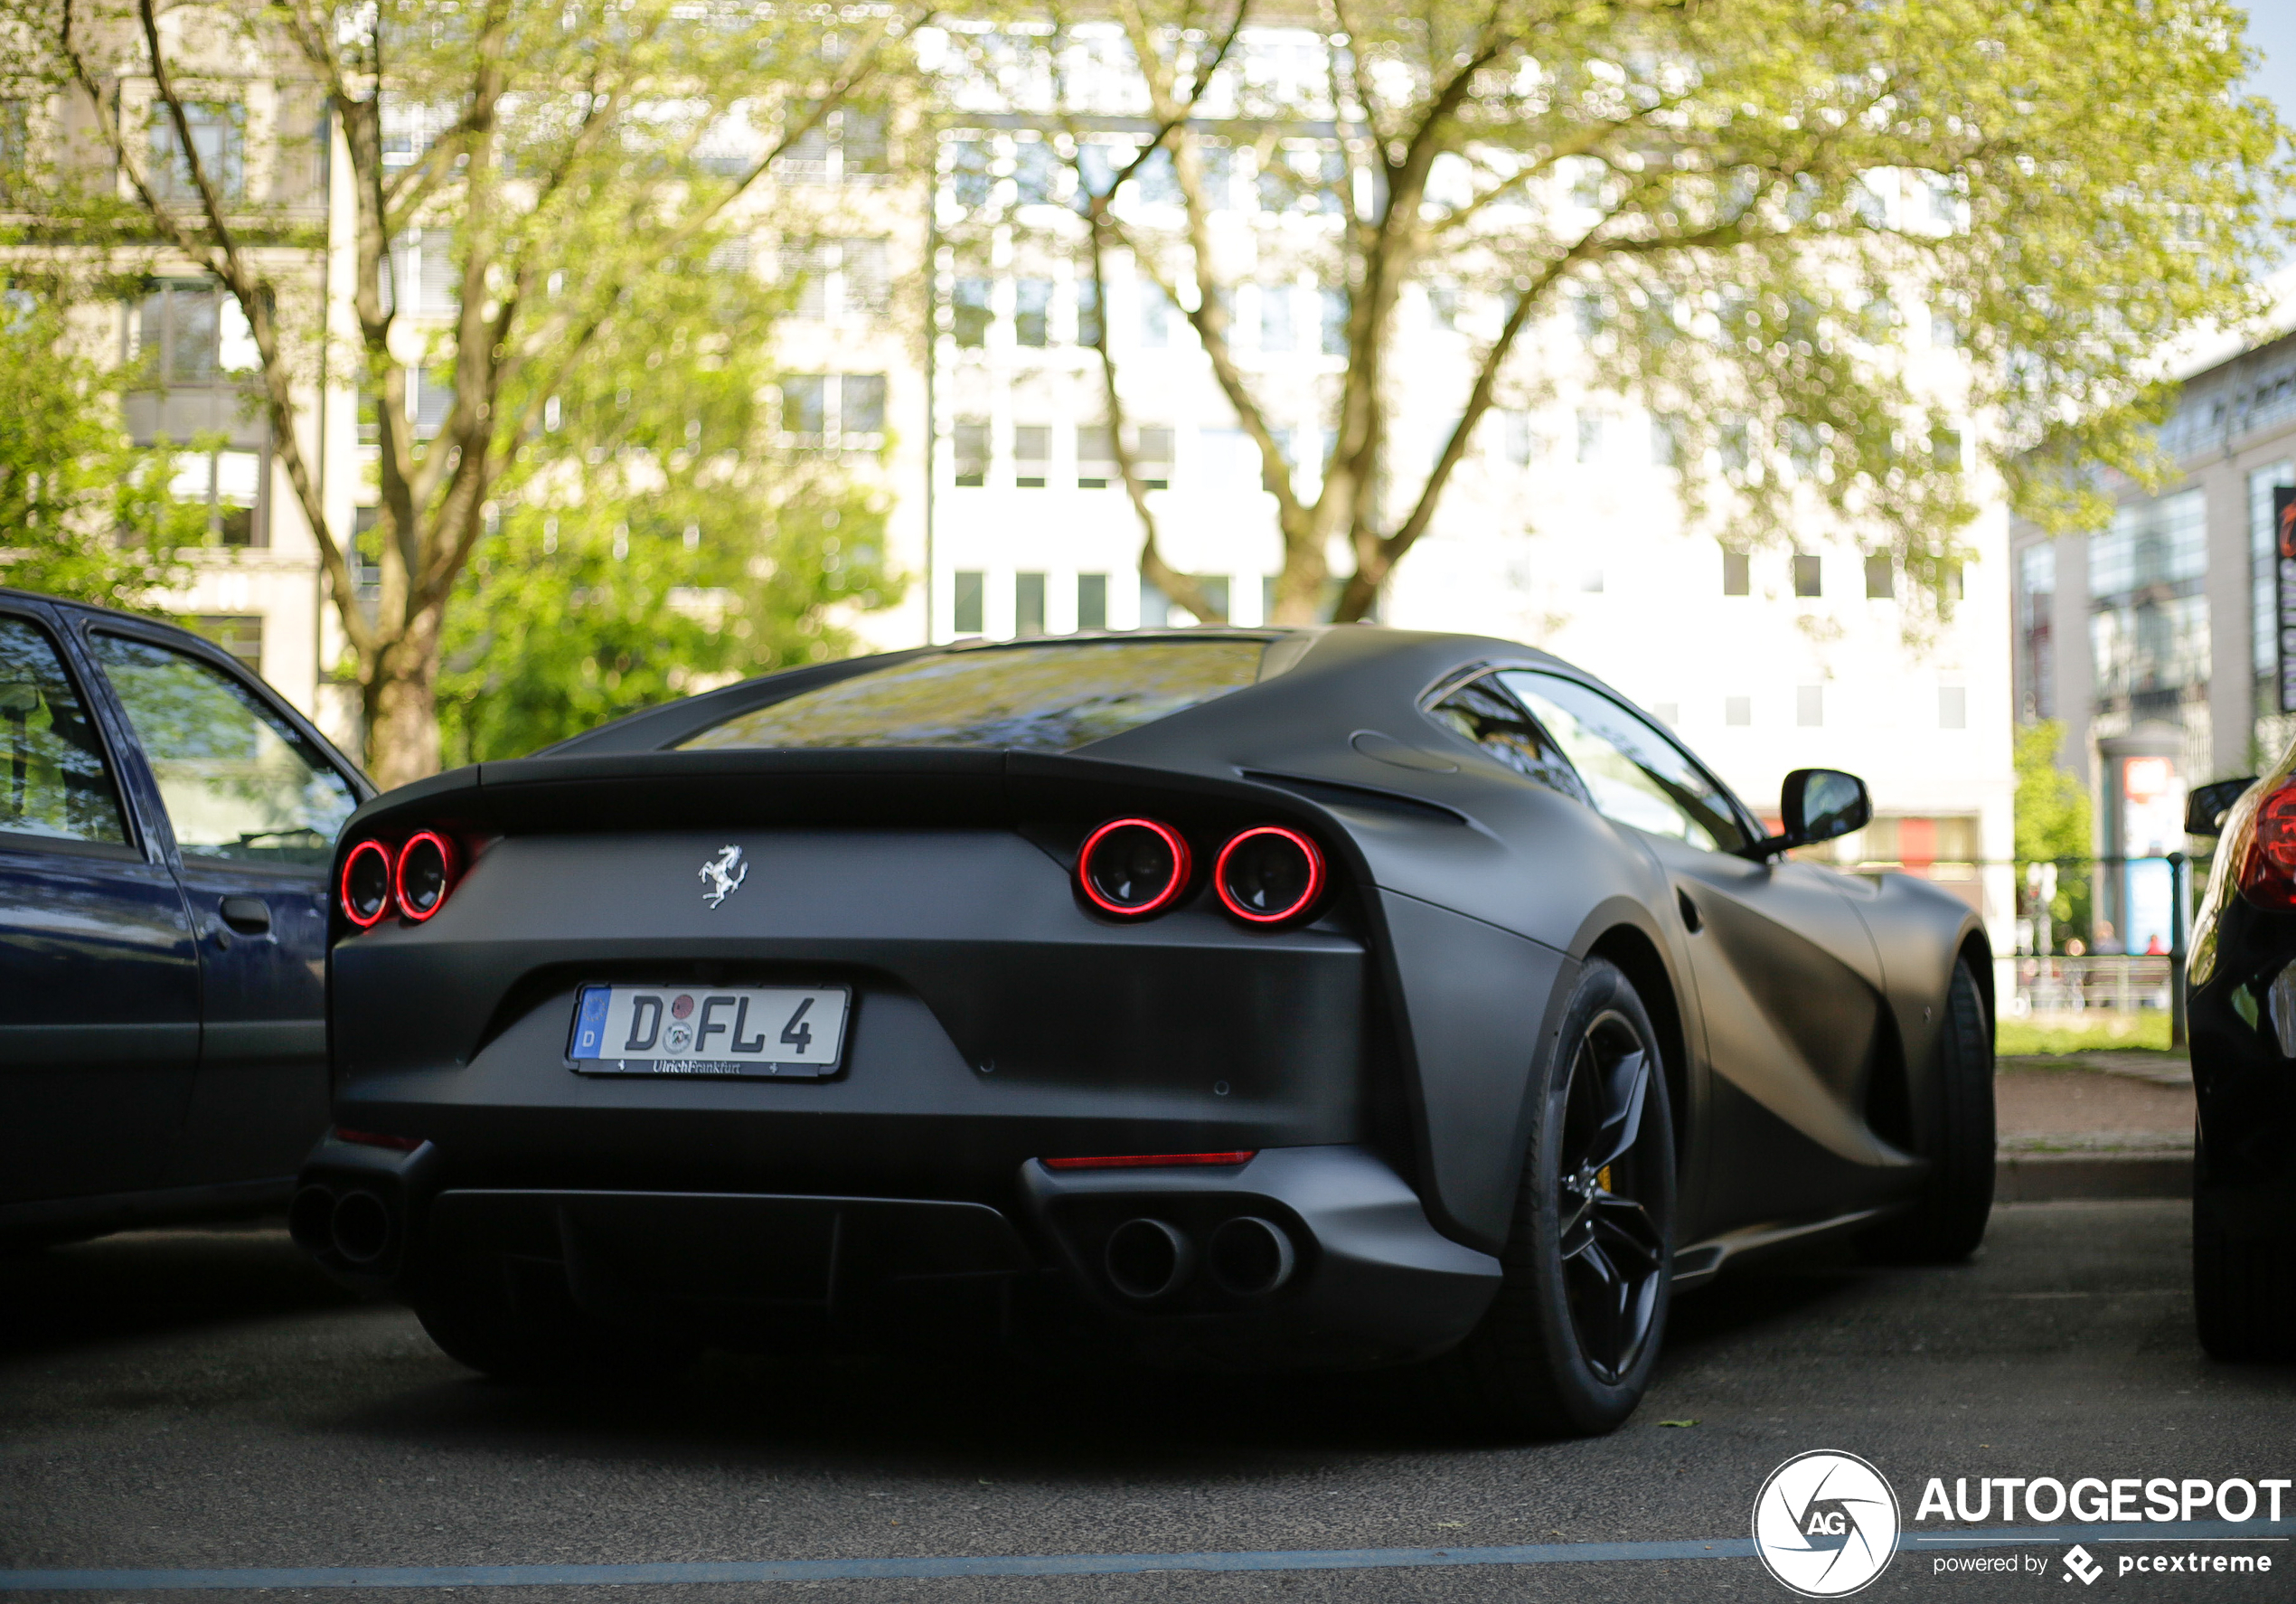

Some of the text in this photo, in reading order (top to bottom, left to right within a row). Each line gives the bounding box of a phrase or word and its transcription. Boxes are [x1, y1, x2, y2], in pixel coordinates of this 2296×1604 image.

[583, 1031, 595, 1047] D
[625, 995, 814, 1053] D FL 4
